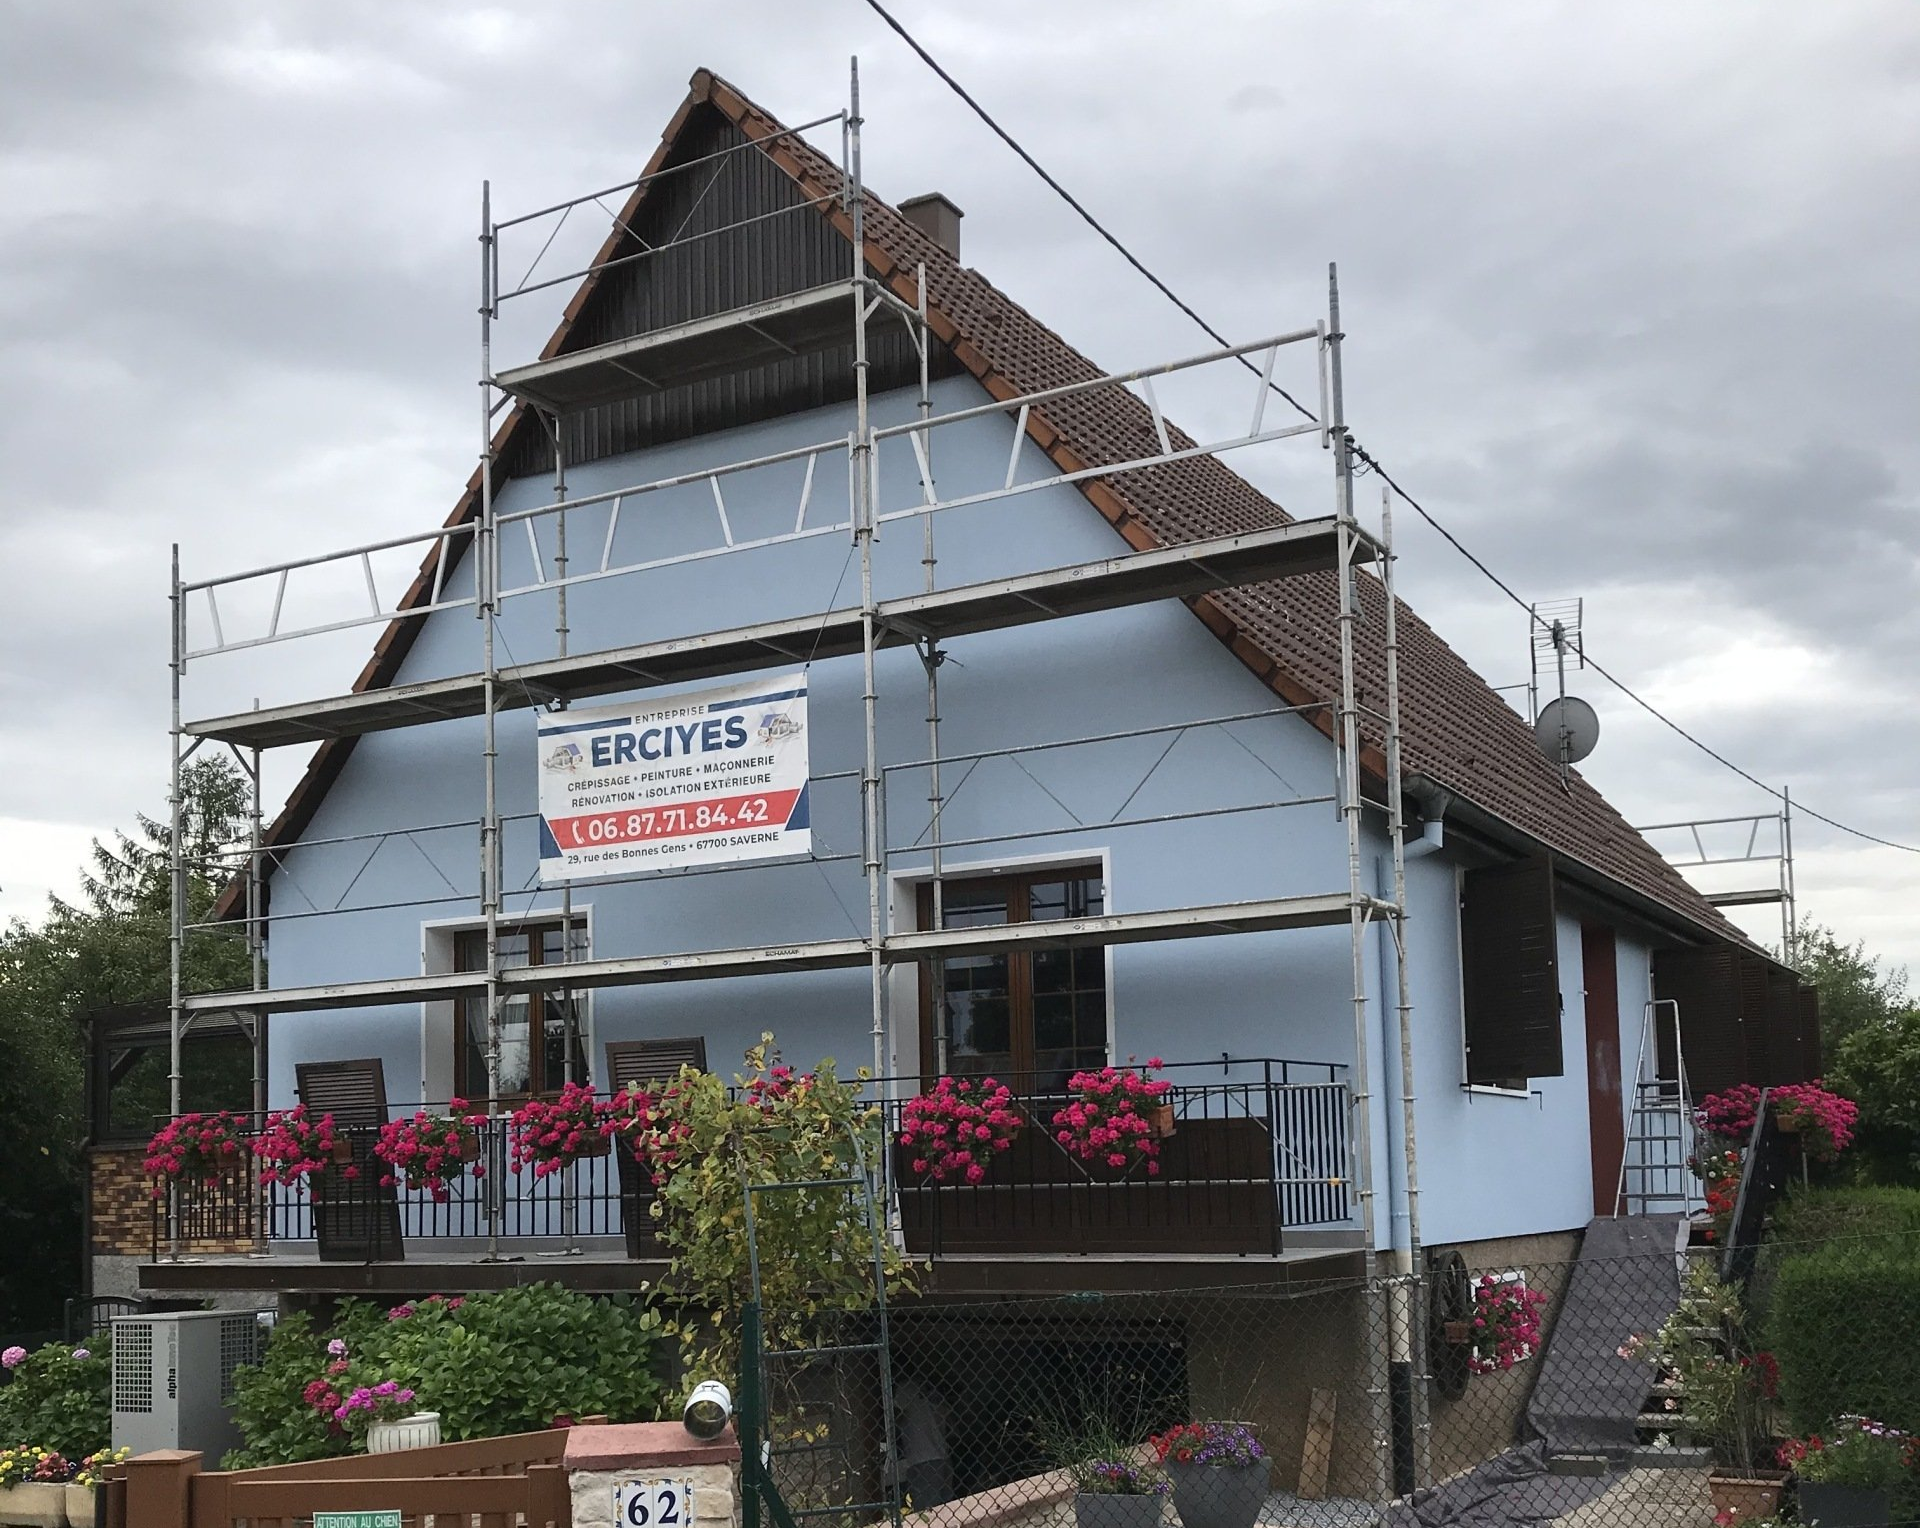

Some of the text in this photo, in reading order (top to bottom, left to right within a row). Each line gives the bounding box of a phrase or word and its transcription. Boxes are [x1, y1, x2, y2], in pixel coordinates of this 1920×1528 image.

[635, 705, 705, 724] ENTREPRISE
[591, 715, 748, 768] ERCIYES
[568, 755, 775, 792] CRÉPISSAGE PEINTURE MAÇONNERIE
[572, 773, 771, 808] RÉNOVATION ISOLATION EXTÉRIEURE
[588, 798, 769, 841] 06.87.71.84.42
[568, 831, 779, 865] 29, rue des Bonnes Gens 67700 SAVERNE
[316, 1514, 398, 1528] ATTENTION AU CHIEN
[628, 1490, 679, 1526] 62
